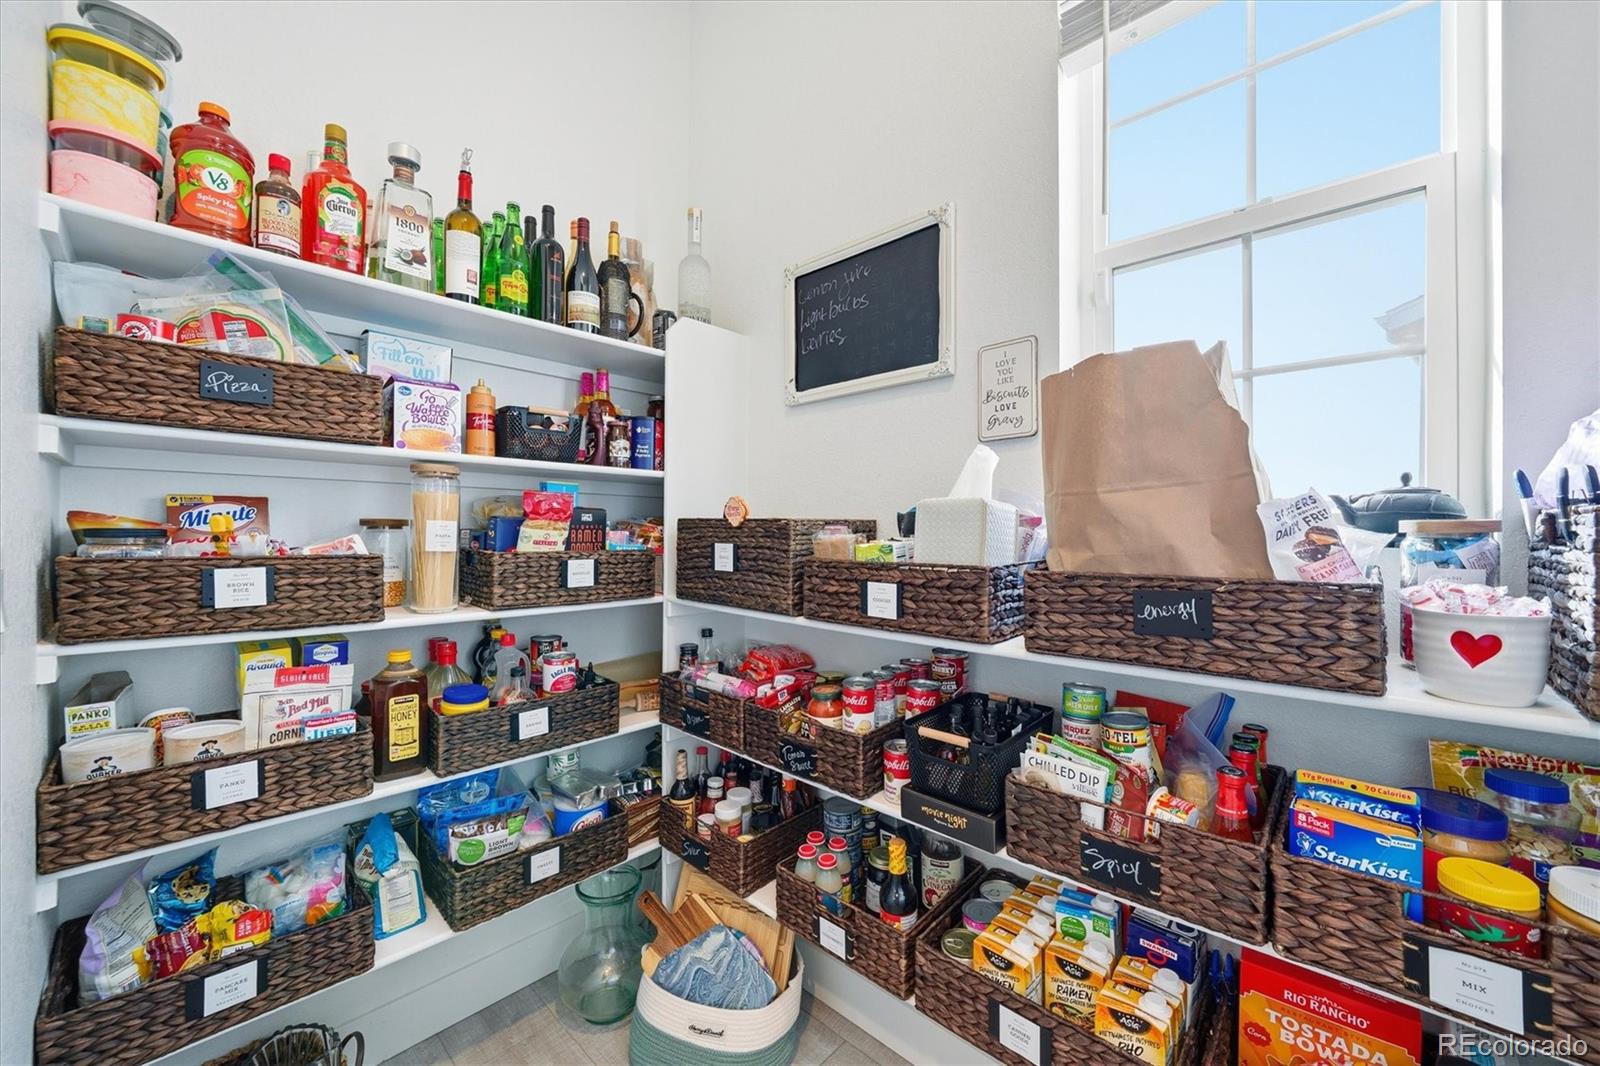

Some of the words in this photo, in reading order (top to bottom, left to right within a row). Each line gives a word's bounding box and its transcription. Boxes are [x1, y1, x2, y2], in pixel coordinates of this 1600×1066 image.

[208, 170, 229, 191] V8
[197, 192, 220, 204] Spicy
[326, 200, 356, 216] Cuervo
[396, 216, 424, 234] 1800
[996, 357, 1016, 368] LOVE
[997, 367, 1014, 376] YOU
[204, 371, 268, 394] Pizza
[997, 376, 1014, 385] LIKE
[424, 396, 436, 404] 10
[983, 386, 1030, 404] Biscuits
[406, 402, 450, 418] Waffle
[994, 402, 1016, 412] LOVE
[180, 506, 258, 529] Miute
[571, 530, 602, 542] RAMEN
[1137, 598, 1198, 624] energy
[288, 702, 308, 717] Red
[308, 695, 330, 711] Mill
[70, 708, 110, 721] PANKO
[391, 711, 417, 722] HONEY
[86, 769, 122, 781] QUAKER
[1028, 756, 1076, 780] CHILLED
[1080, 772, 1100, 787] DIP
[219, 779, 246, 789] PANKO
[1302, 772, 1316, 781] 17g
[1318, 774, 1345, 786] Protein
[1378, 788, 1412, 800] Calories
[1448, 786, 1478, 799] BIG
[1320, 791, 1402, 823] StarKist
[945, 812, 968, 829] night
[1297, 813, 1306, 822] 8
[1307, 815, 1329, 830] Pack
[488, 838, 508, 848] LIGHT
[488, 841, 514, 852] BROWN
[1085, 849, 1142, 885] Spicy
[1314, 845, 1410, 882] StarKist
[1140, 939, 1176, 959] SWANSON
[214, 977, 248, 993] PANCAKE
[1462, 980, 1487, 994] MIX
[1056, 985, 1093, 1002] RAMEN
[1284, 989, 1307, 1006] RIO
[1310, 1000, 1368, 1029] RANCHO
[1265, 1008, 1388, 1066] TOSTADA
